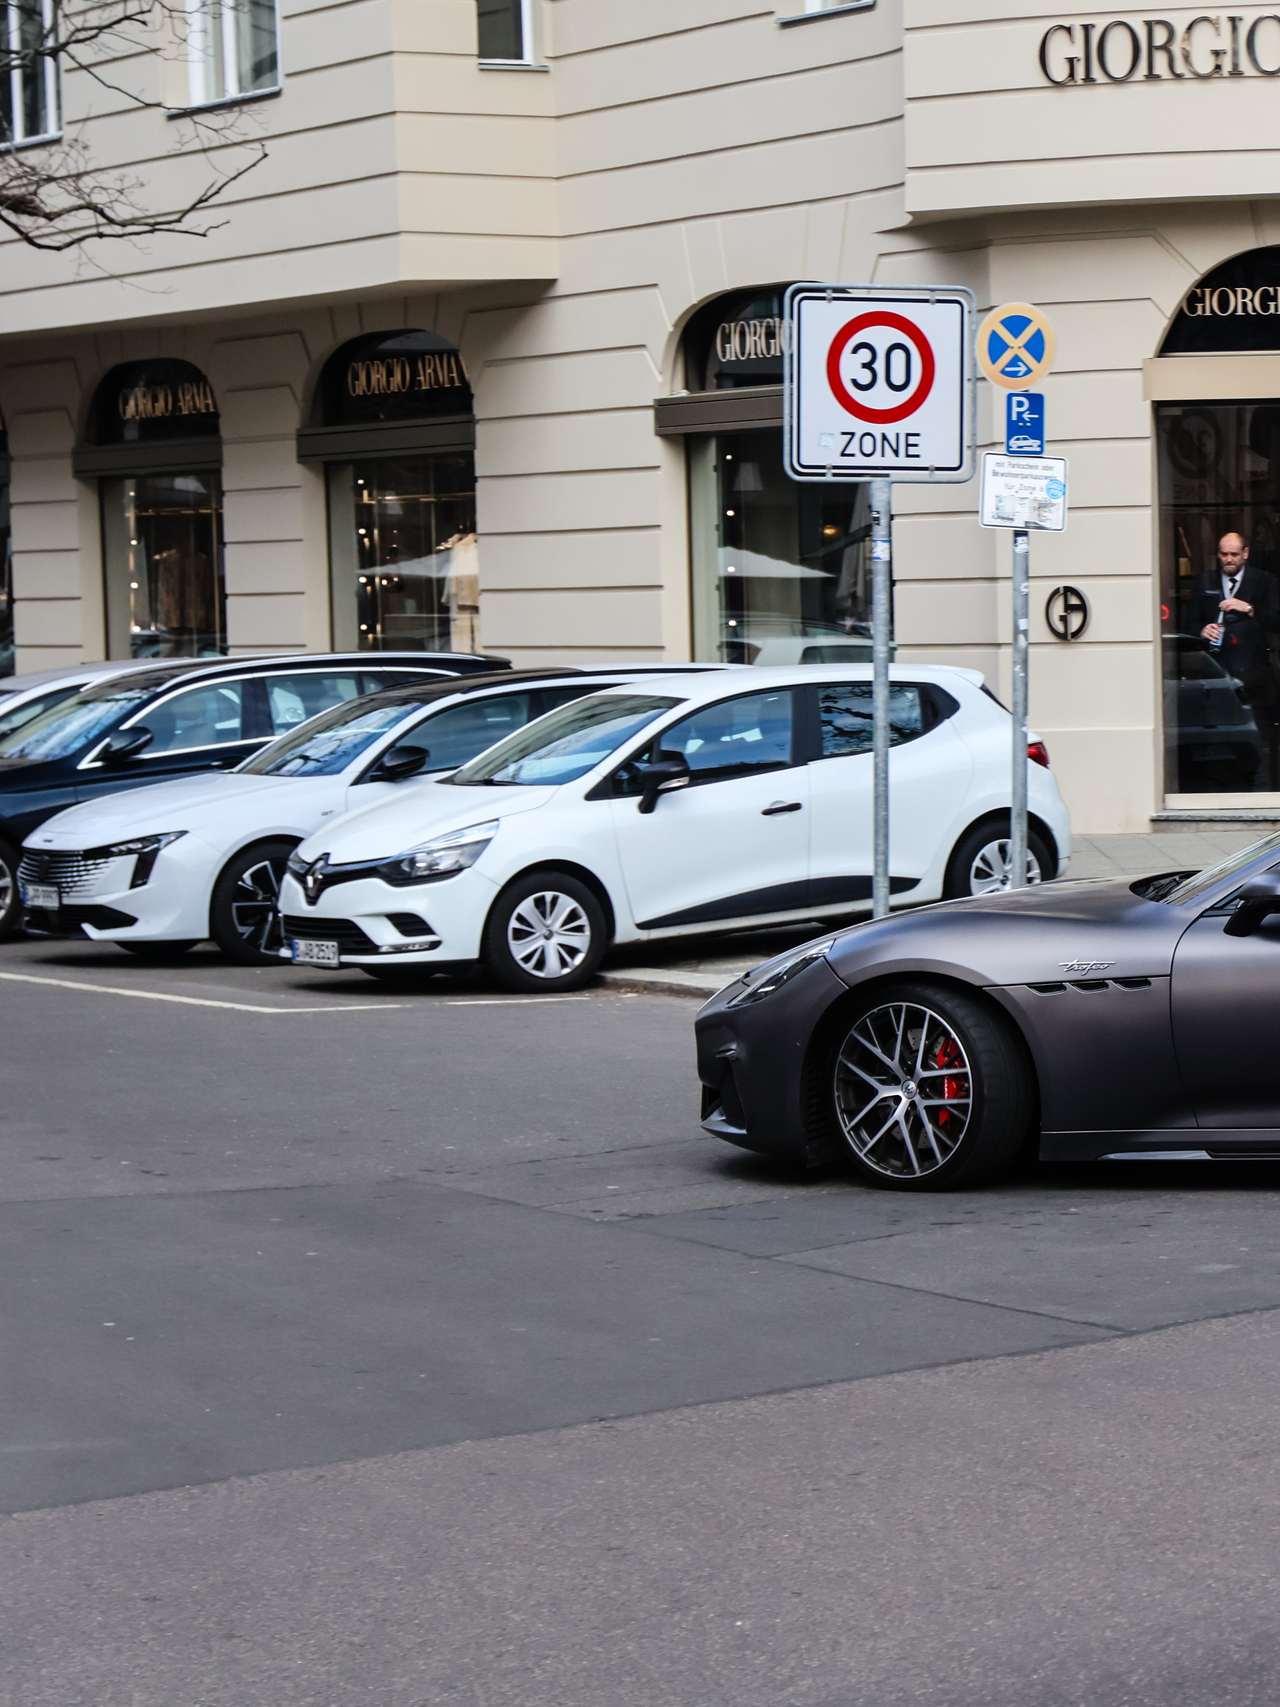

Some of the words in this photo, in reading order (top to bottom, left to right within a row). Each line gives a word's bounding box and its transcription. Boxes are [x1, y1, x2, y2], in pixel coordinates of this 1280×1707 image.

[348, 357, 411, 397] GIORGIO
[850, 341, 912, 393] 30
[840, 431, 921, 458] ZONE
